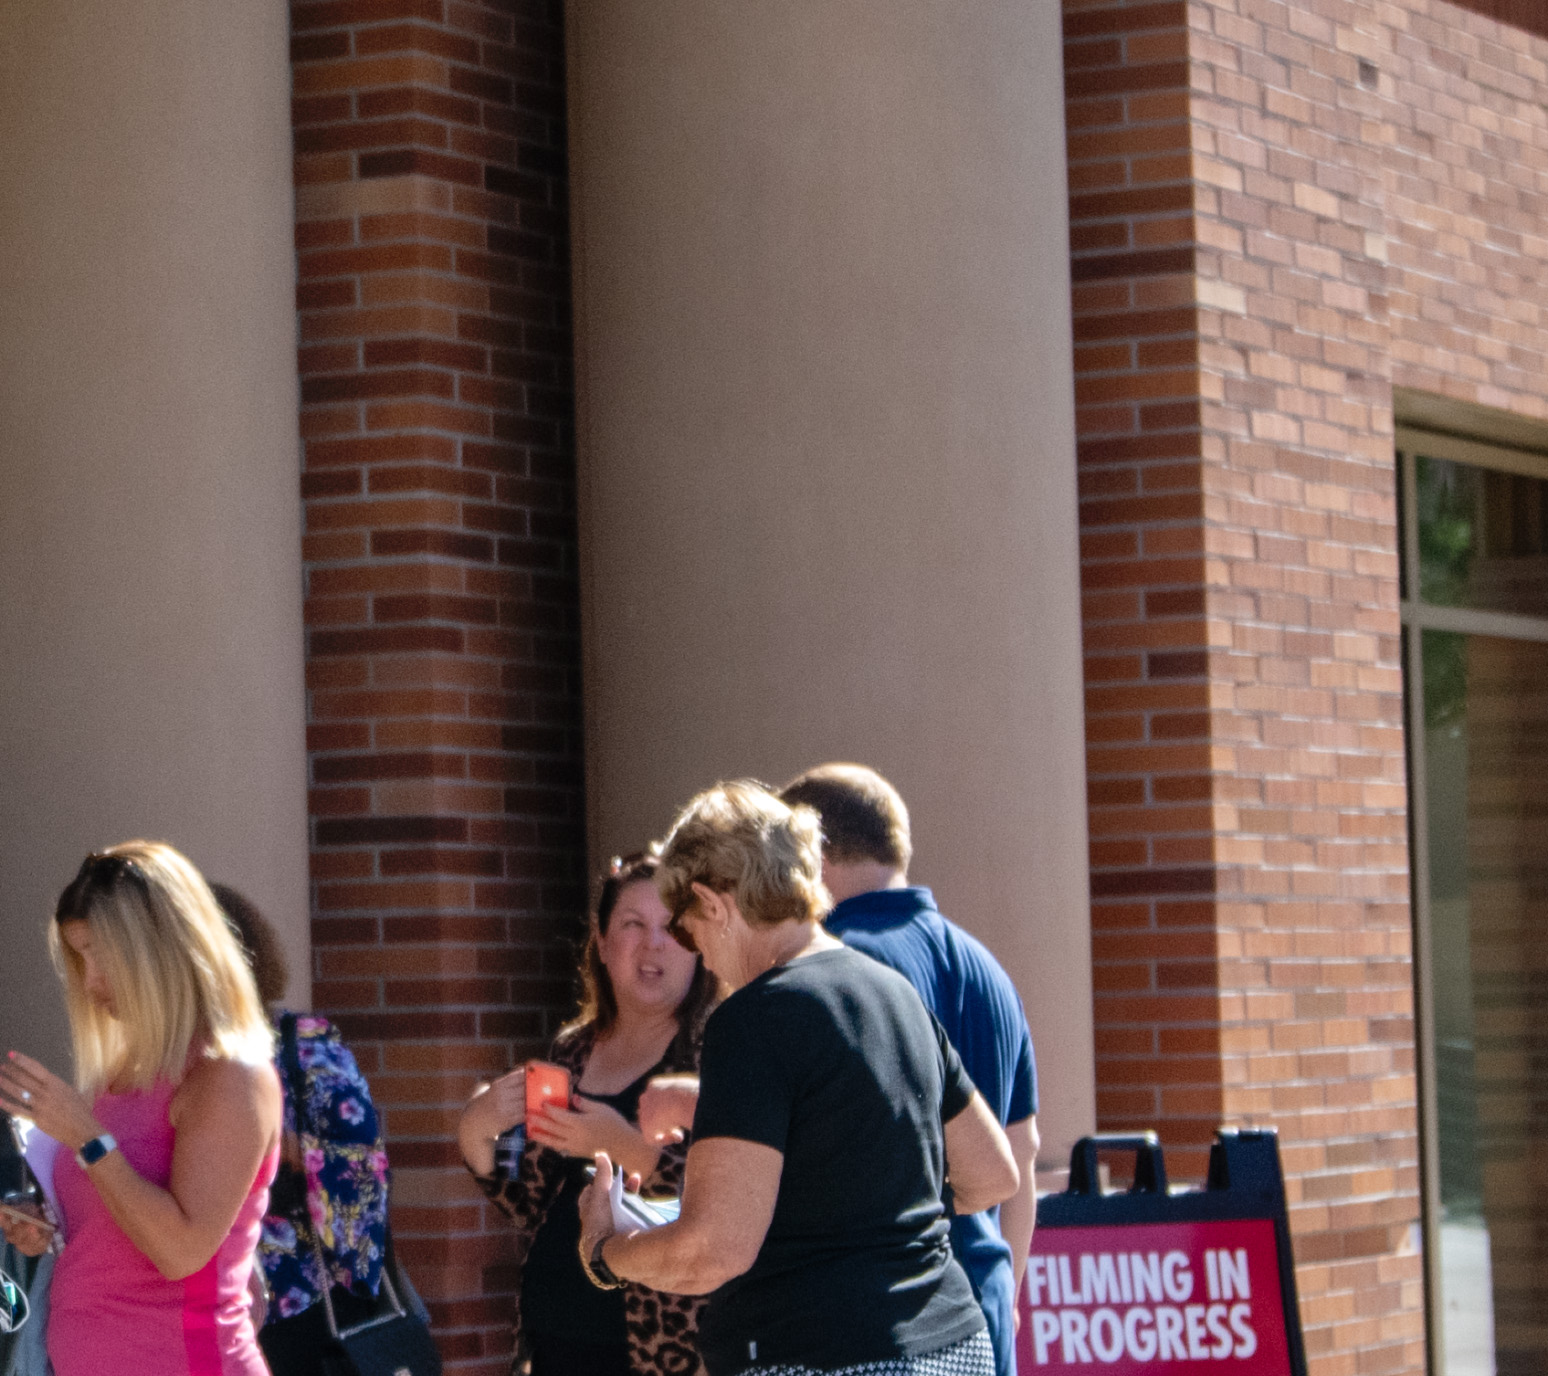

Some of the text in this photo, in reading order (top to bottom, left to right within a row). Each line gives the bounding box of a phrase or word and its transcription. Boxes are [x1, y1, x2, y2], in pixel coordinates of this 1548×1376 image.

[1027, 1247, 1252, 1307] FILMING IN
[1031, 1302, 1258, 1366] PROGRESS
